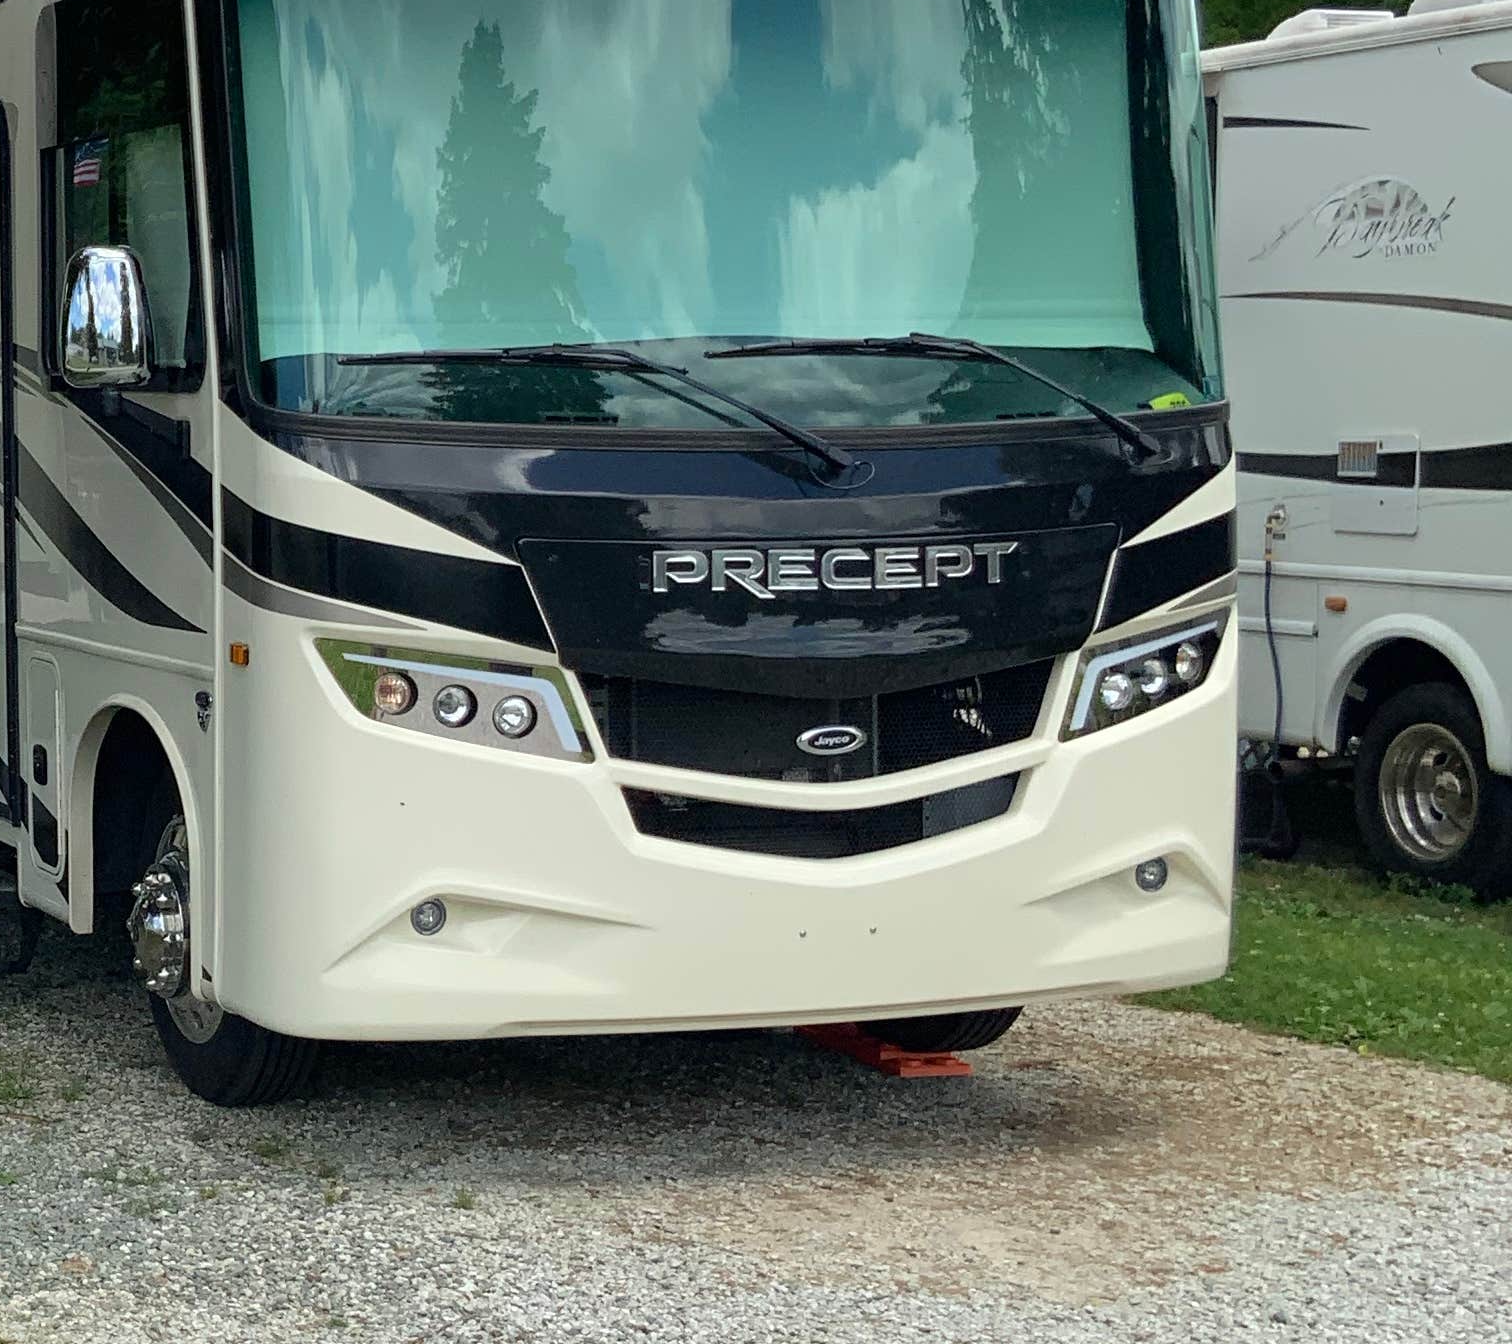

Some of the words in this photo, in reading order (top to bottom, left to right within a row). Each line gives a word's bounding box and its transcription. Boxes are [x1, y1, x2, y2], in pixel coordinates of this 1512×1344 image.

[1384, 242, 1437, 258] DAMON
[652, 541, 1019, 600] PRECEPT
[813, 735, 850, 747] Jayco
